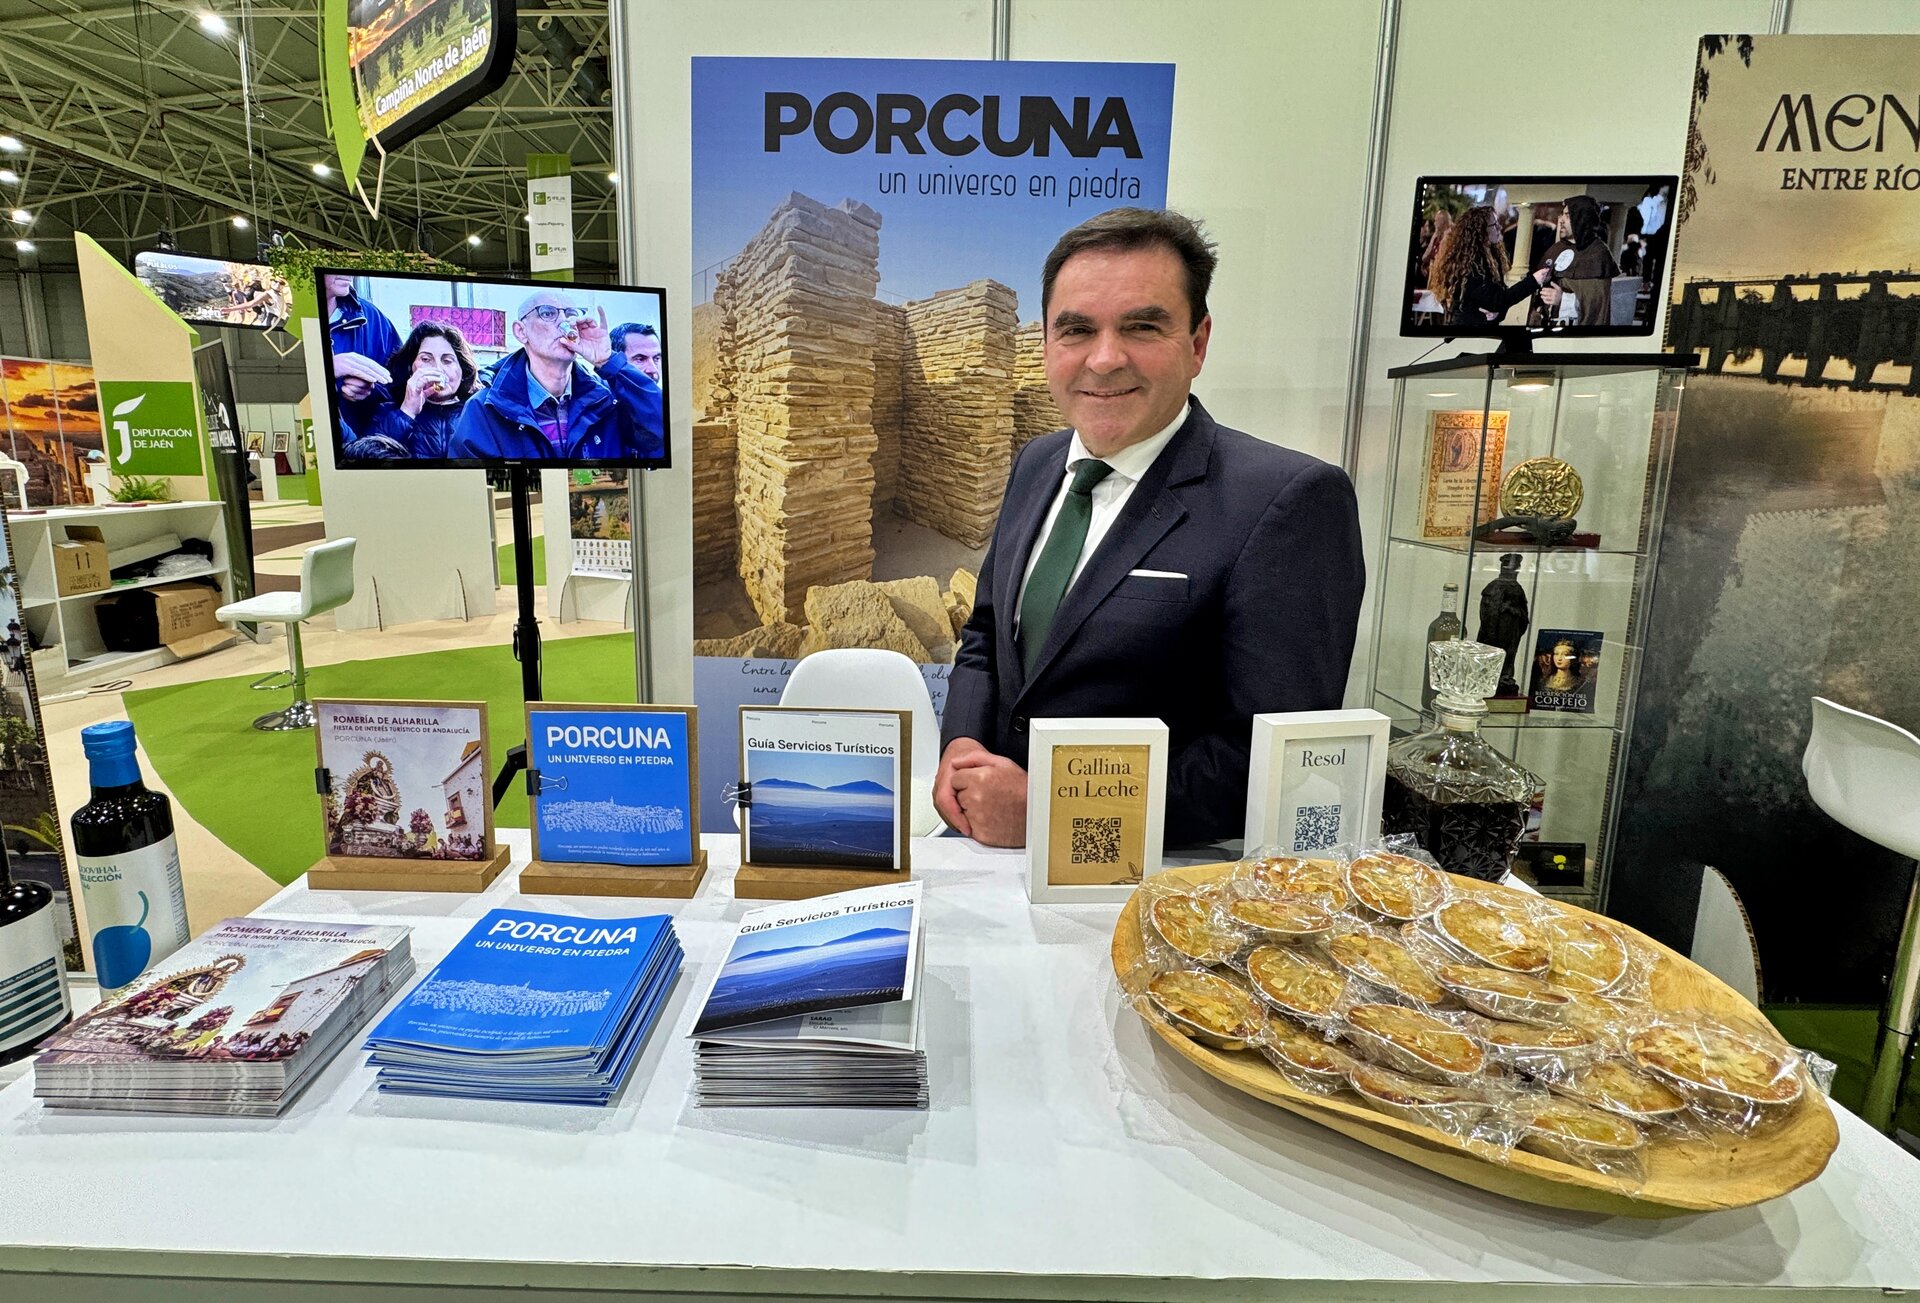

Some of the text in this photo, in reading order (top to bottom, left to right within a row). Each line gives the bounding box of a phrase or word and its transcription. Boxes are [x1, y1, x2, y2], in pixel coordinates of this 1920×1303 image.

[375, 26, 487, 116] Campiña Norte de Jaén
[764, 92, 1143, 158] PORCUNA
[878, 165, 1142, 208] un universo en piedra
[1780, 167, 1868, 191] ENTRE
[131, 427, 193, 438] DIPUTACIÓN
[133, 438, 174, 449] DE JAÉN
[741, 659, 777, 676] Entre
[752, 685, 780, 694] una
[1534, 695, 1588, 707] CORTEJO
[333, 715, 440, 727] ROMERÍA DE ALHARILLA
[389, 726, 421, 734] TURÍSTICO
[432, 727, 470, 735] ANDALUCÍA
[546, 725, 672, 750] PORCUNA
[747, 737, 895, 756] Guía Servicios Turísticos
[548, 754, 674, 765] UN UNIVERSO EN PIEDRA
[1067, 757, 1132, 777] Gallina
[1301, 748, 1346, 769] Resol
[1057, 780, 1140, 798] en Leche
[740, 898, 914, 934] Guía Servicios Turísticos
[214, 932, 239, 940] FIESTA
[250, 933, 279, 941] INTERÉS
[331, 937, 377, 945] ANDALUCÍA
[222, 925, 272, 935] ROMERÍA
[293, 929, 348, 938] ALHARILLA
[488, 919, 638, 945] PORCUNA
[475, 940, 630, 957] UN UNIVERSO EN PIEDRA
